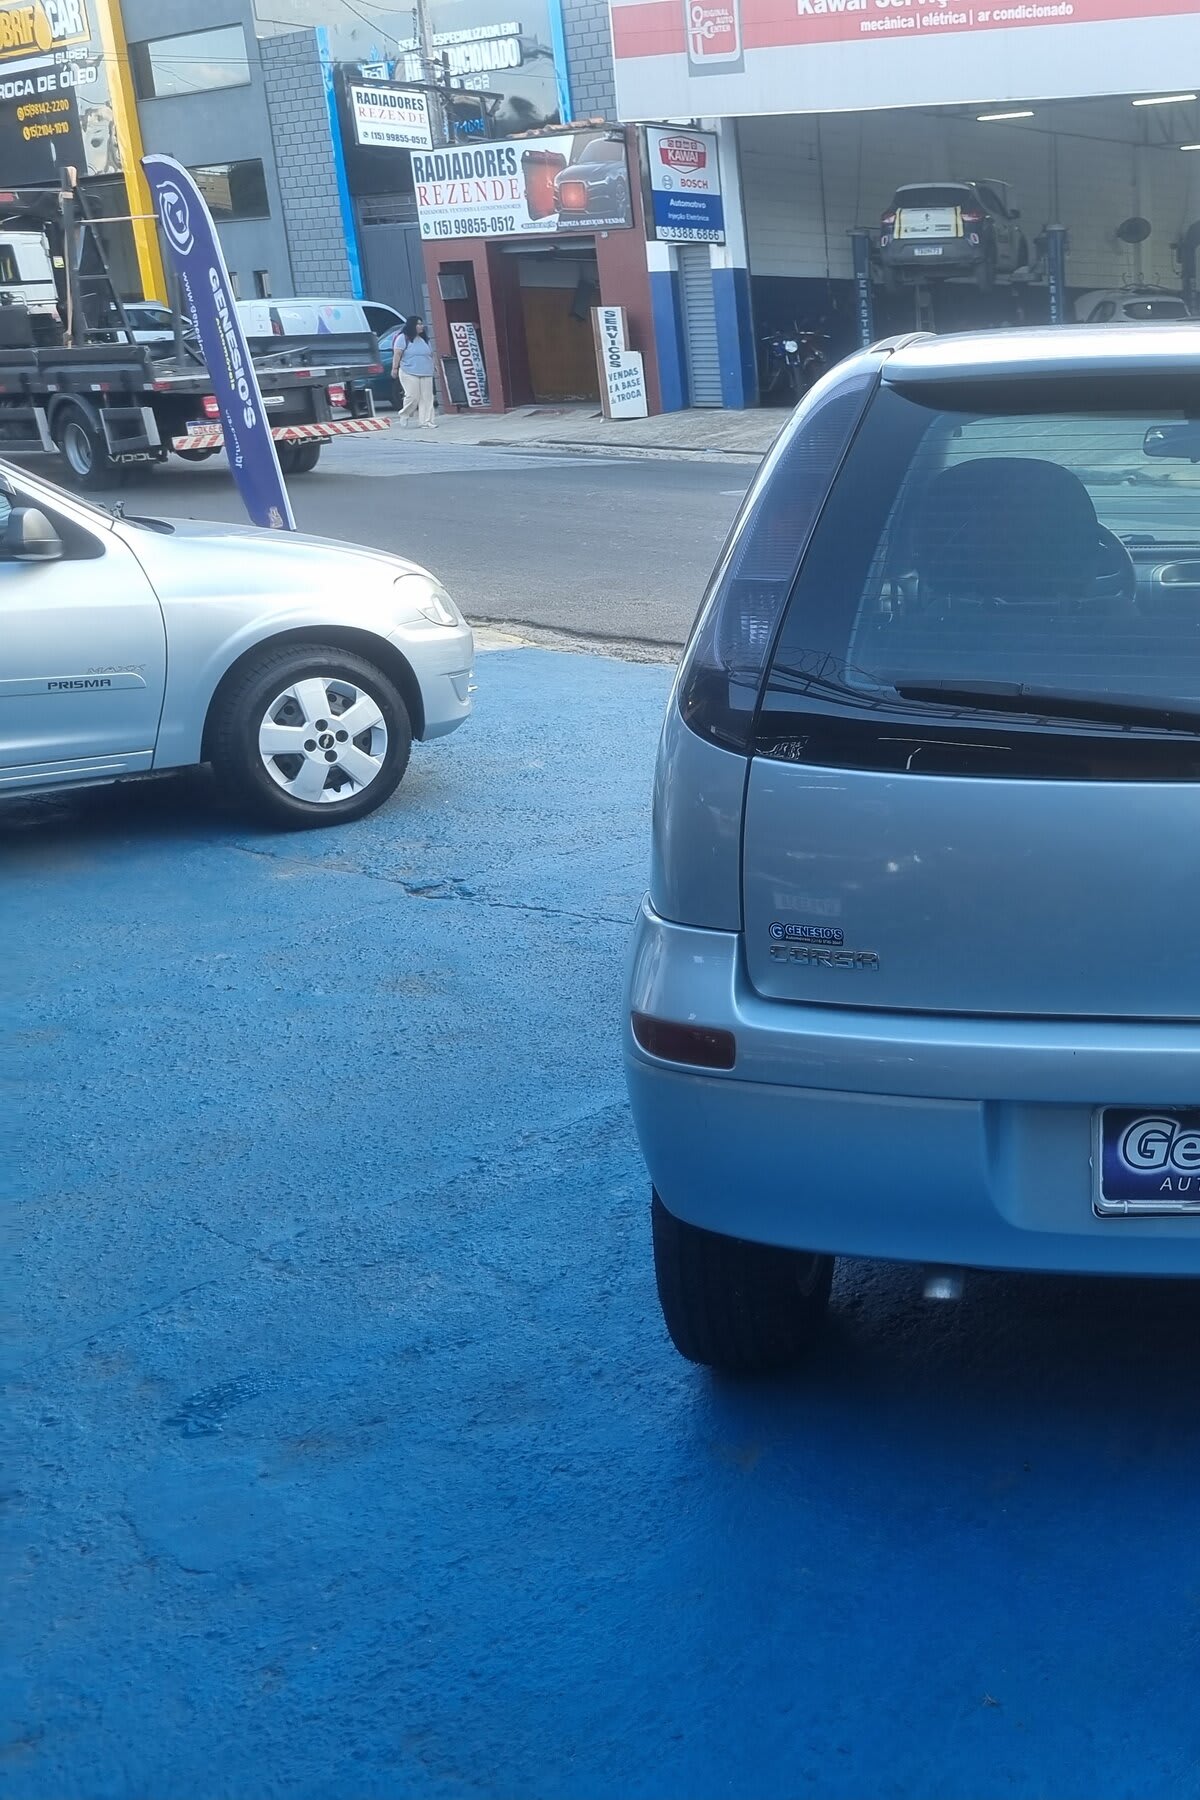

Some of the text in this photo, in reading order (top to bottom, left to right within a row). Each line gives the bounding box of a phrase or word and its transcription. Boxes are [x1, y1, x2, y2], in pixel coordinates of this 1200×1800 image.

[860, 16, 915, 32] mecânica
[922, 11, 967, 26] elétrica
[977, 10, 991, 22] ar
[993, 1, 1074, 21] condicionado
[55, 47, 88, 65] SUPER
[37, 74, 57, 93] DE
[59, 65, 97, 88] ÓLEO
[355, 91, 425, 112] RADIADORES
[358, 106, 427, 125] REZENDE
[412, 147, 518, 184] RADIADORES
[667, 149, 699, 163] KAWAI
[416, 178, 522, 207] REZENDE
[680, 178, 709, 189] BOSCH
[433, 220, 453, 236] (15)
[453, 215, 516, 235] 99855-0512
[604, 310, 622, 368] SERVICOS
[453, 324, 483, 406] RADIADORES
[608, 367, 639, 382] VENDAS
[621, 377, 641, 390] BASE
[617, 388, 642, 402] TROCA
[47, 678, 112, 691] PRISMA
[784, 923, 844, 941] GENESIO'S
[768, 944, 881, 971] CORSA
